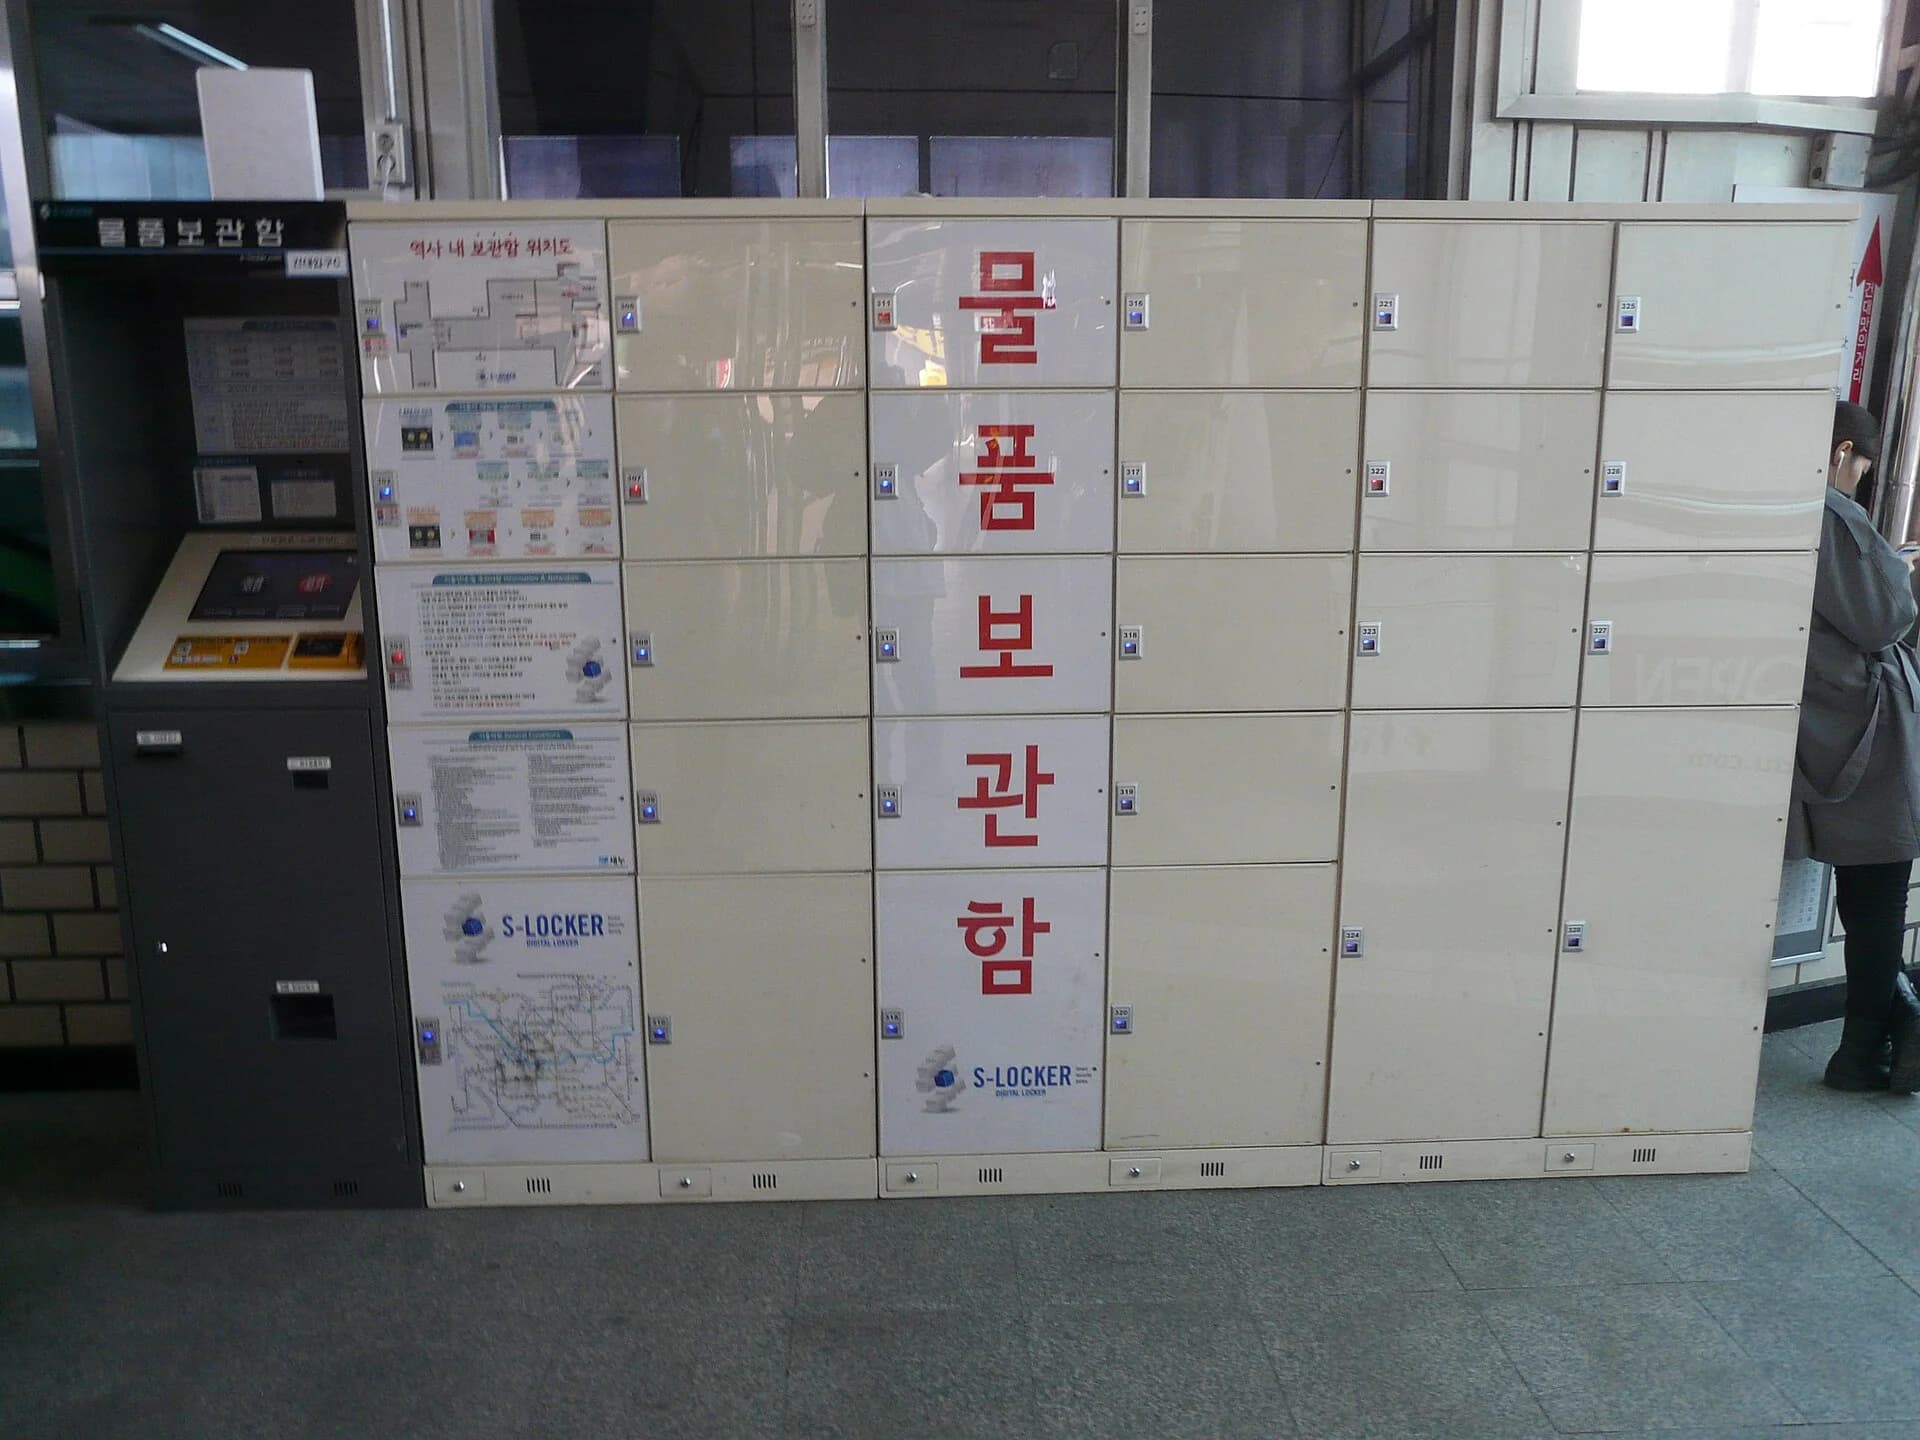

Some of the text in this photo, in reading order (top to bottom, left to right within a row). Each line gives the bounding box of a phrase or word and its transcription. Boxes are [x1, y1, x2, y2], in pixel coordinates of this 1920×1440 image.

[449, 237, 465, 257] 내
[471, 237, 519, 258] 보관함
[1126, 468, 1140, 476] 317
[880, 634, 894, 642] 313
[882, 790, 896, 798] 314
[1120, 788, 1134, 796] 319
[502, 914, 604, 938] S-LOCKER
[973, 1065, 1072, 1088] S-LOCKER
[1022, 1088, 1046, 1096] LOCKER
